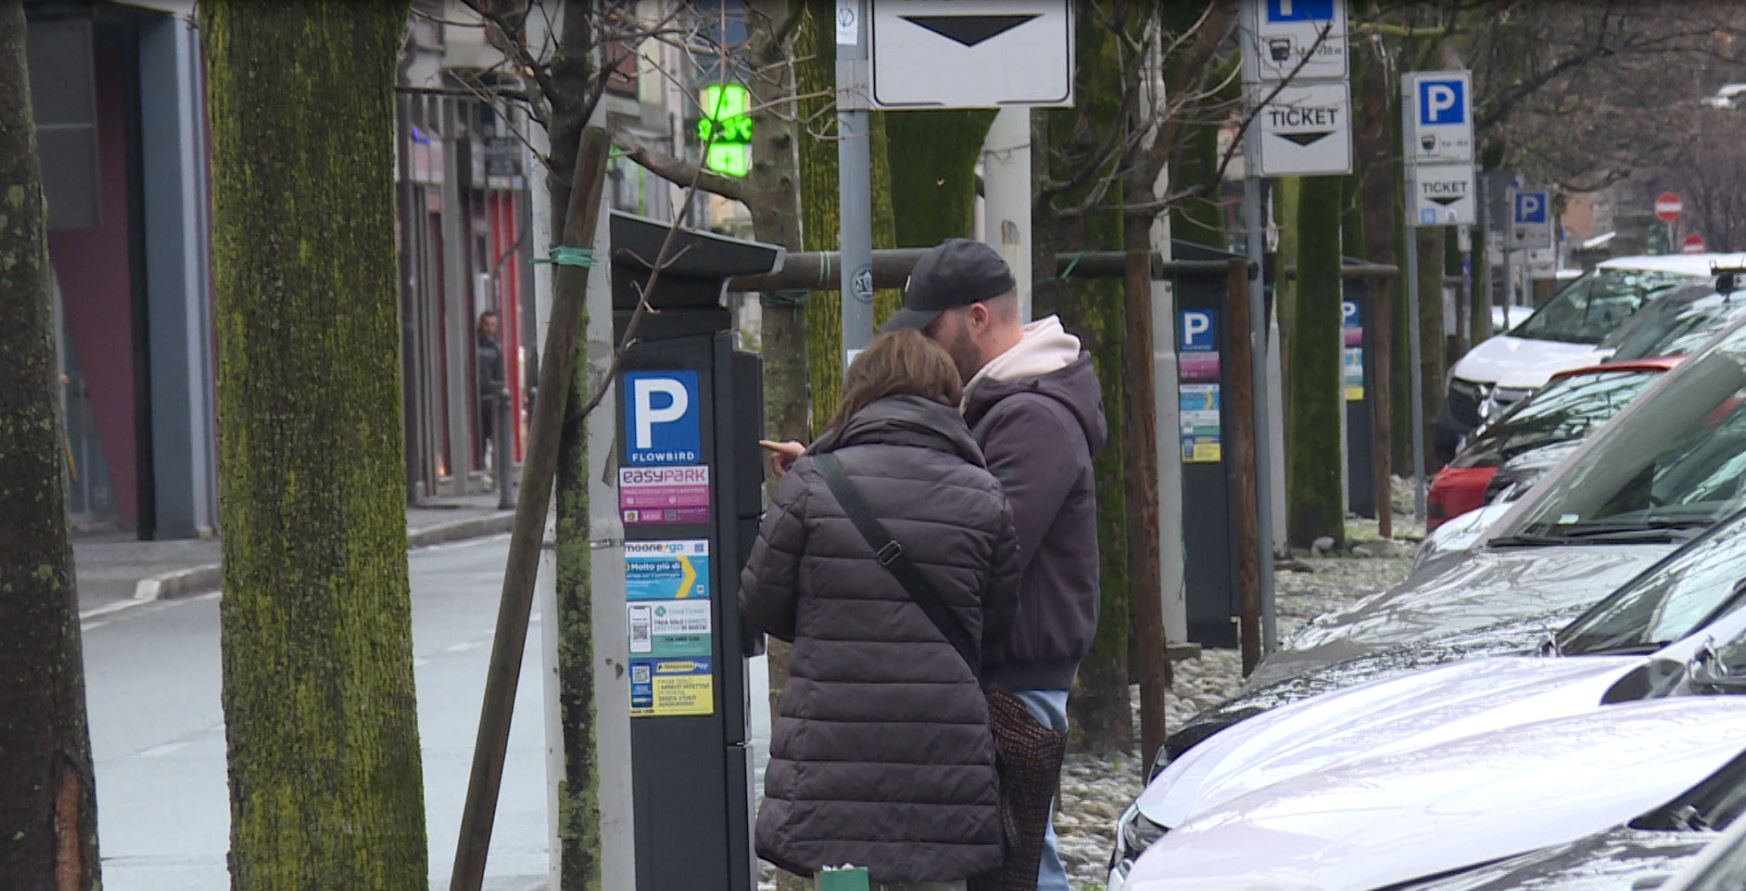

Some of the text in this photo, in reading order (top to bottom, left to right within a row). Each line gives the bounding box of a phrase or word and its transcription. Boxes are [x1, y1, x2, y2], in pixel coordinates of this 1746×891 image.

[1428, 84, 1455, 122] P
[1269, 108, 1339, 127] TICKET
[1422, 181, 1468, 194] TICKET
[1520, 195, 1539, 221] P
[1184, 311, 1210, 345] P
[634, 378, 689, 449] P
[632, 451, 695, 462] FLOWBIRD
